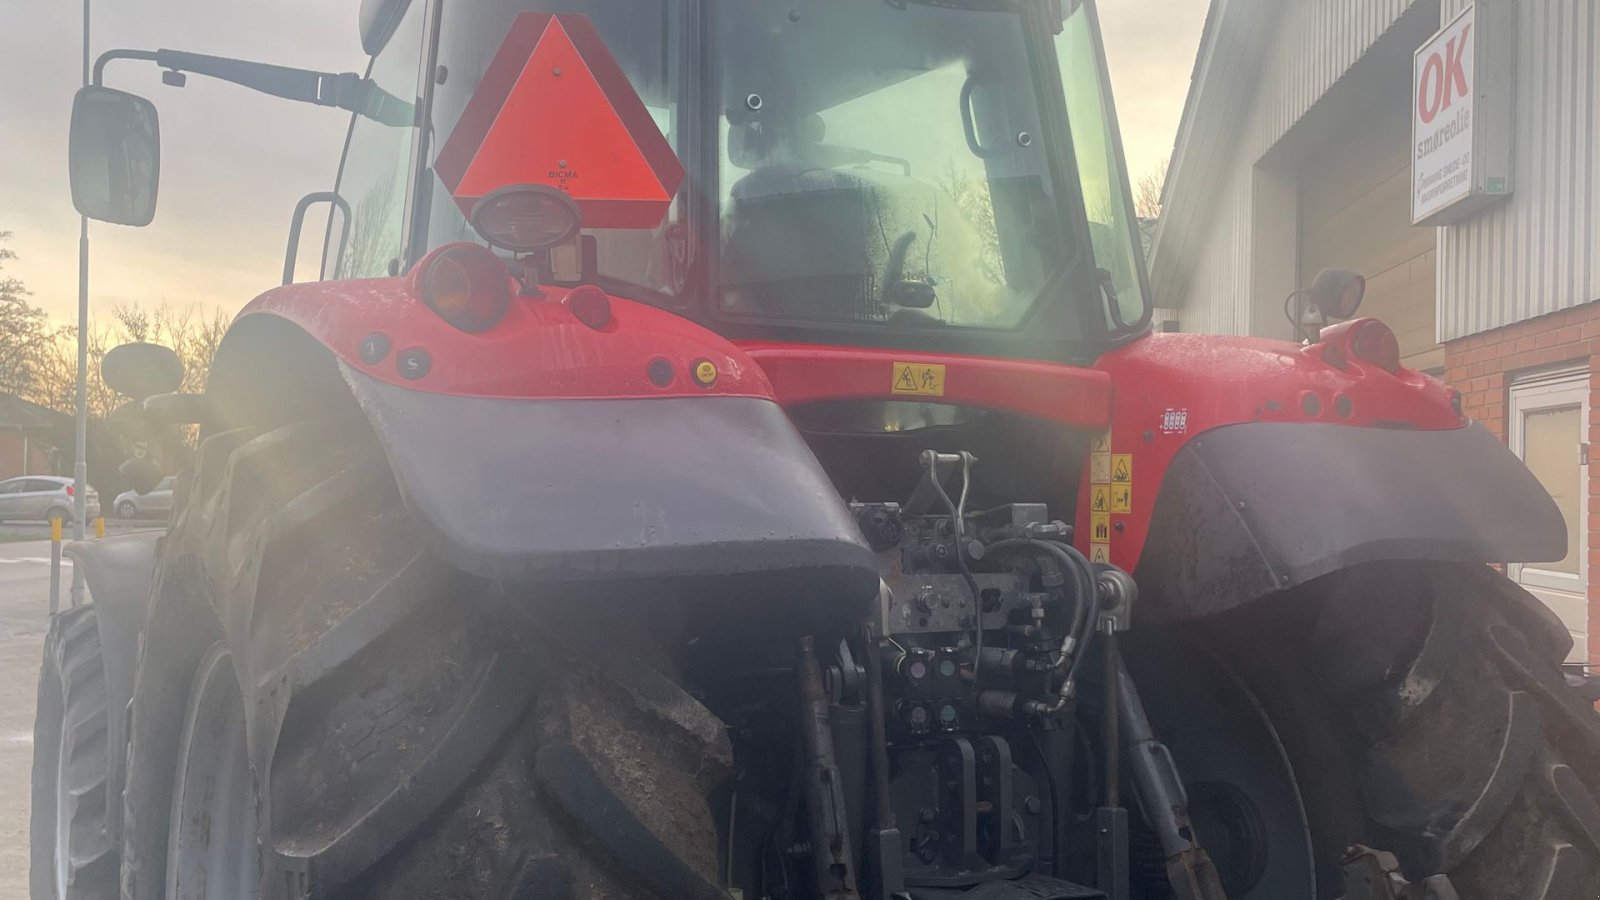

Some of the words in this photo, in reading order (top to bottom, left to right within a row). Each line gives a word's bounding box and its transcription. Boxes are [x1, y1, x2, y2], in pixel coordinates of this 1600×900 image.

[1419, 22, 1471, 124] OK
[1417, 107, 1470, 160] smøreolie
[548, 170, 578, 178] BICMA
